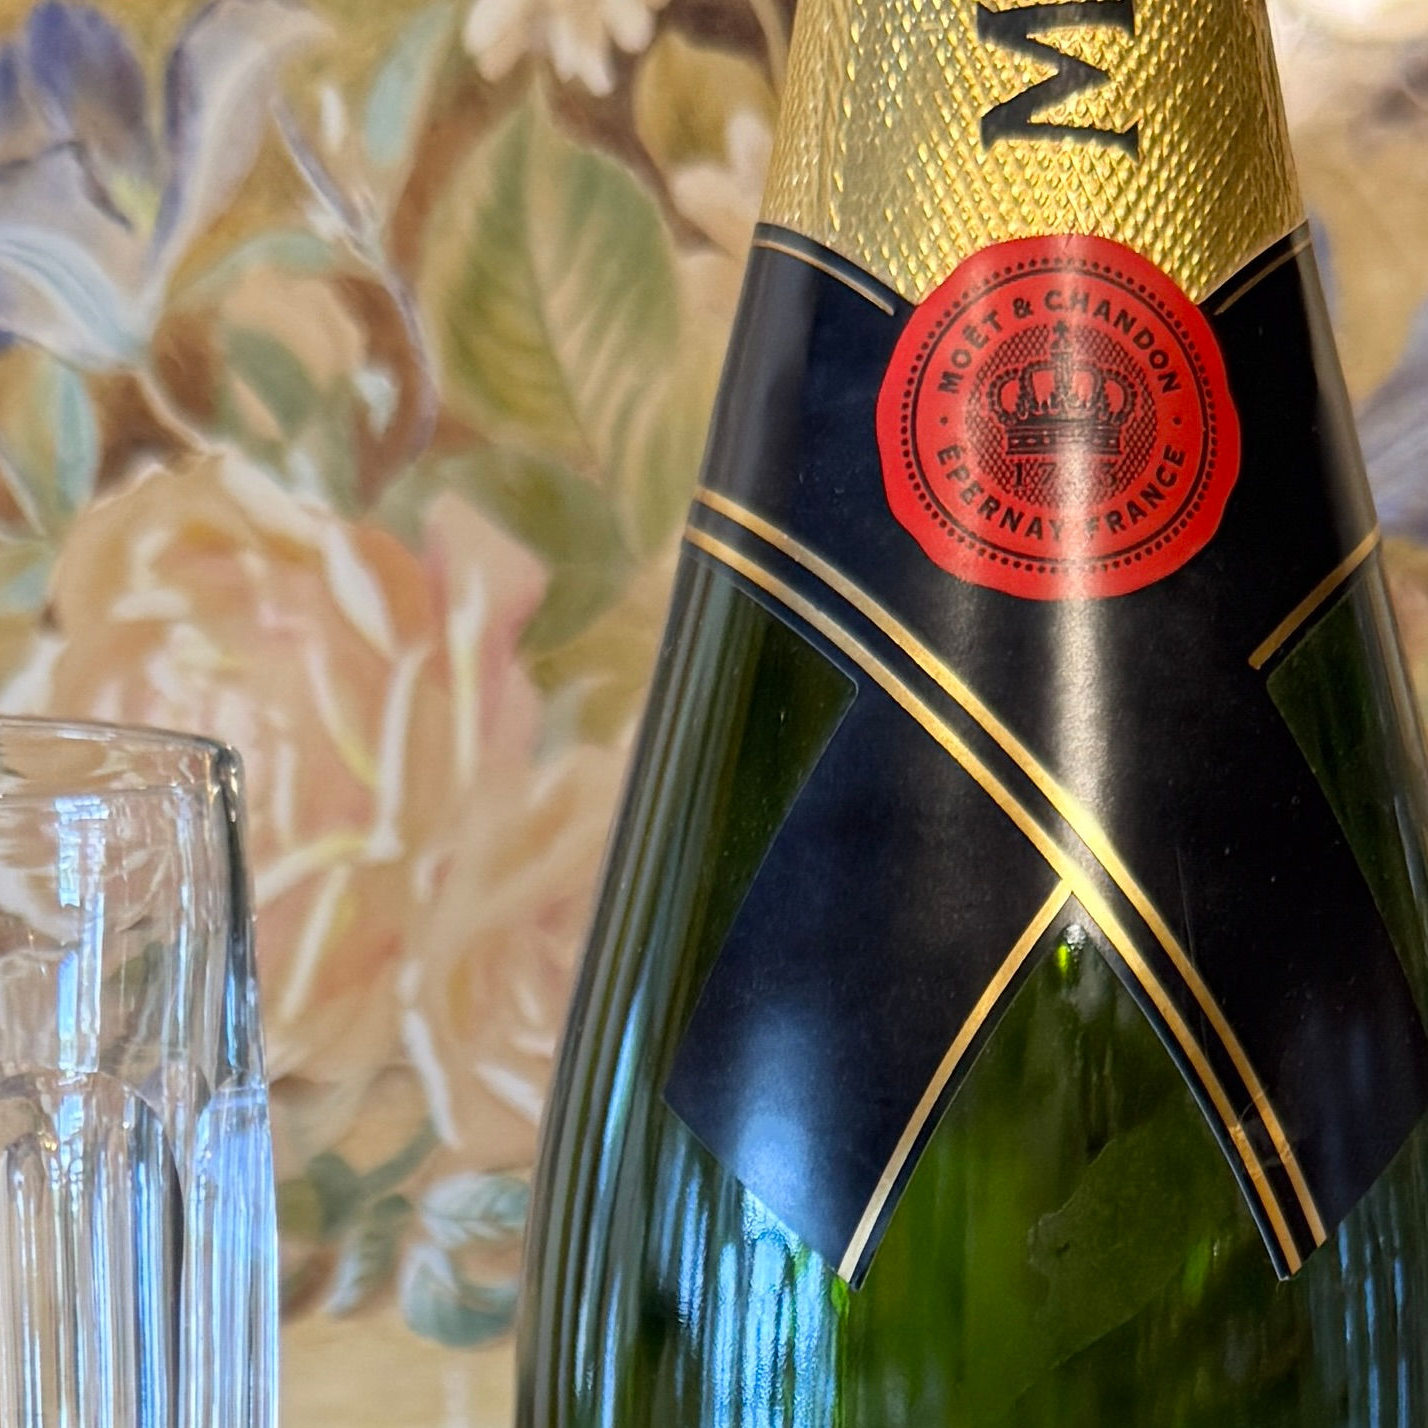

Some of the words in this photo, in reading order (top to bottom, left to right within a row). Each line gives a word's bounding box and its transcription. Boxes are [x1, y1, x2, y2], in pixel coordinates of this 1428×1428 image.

[1013, 298, 1034, 319] &
[1043, 289, 1181, 394] CHANDON
[1013, 461, 1120, 491] 173
[1084, 444, 1186, 538] FRANCE
